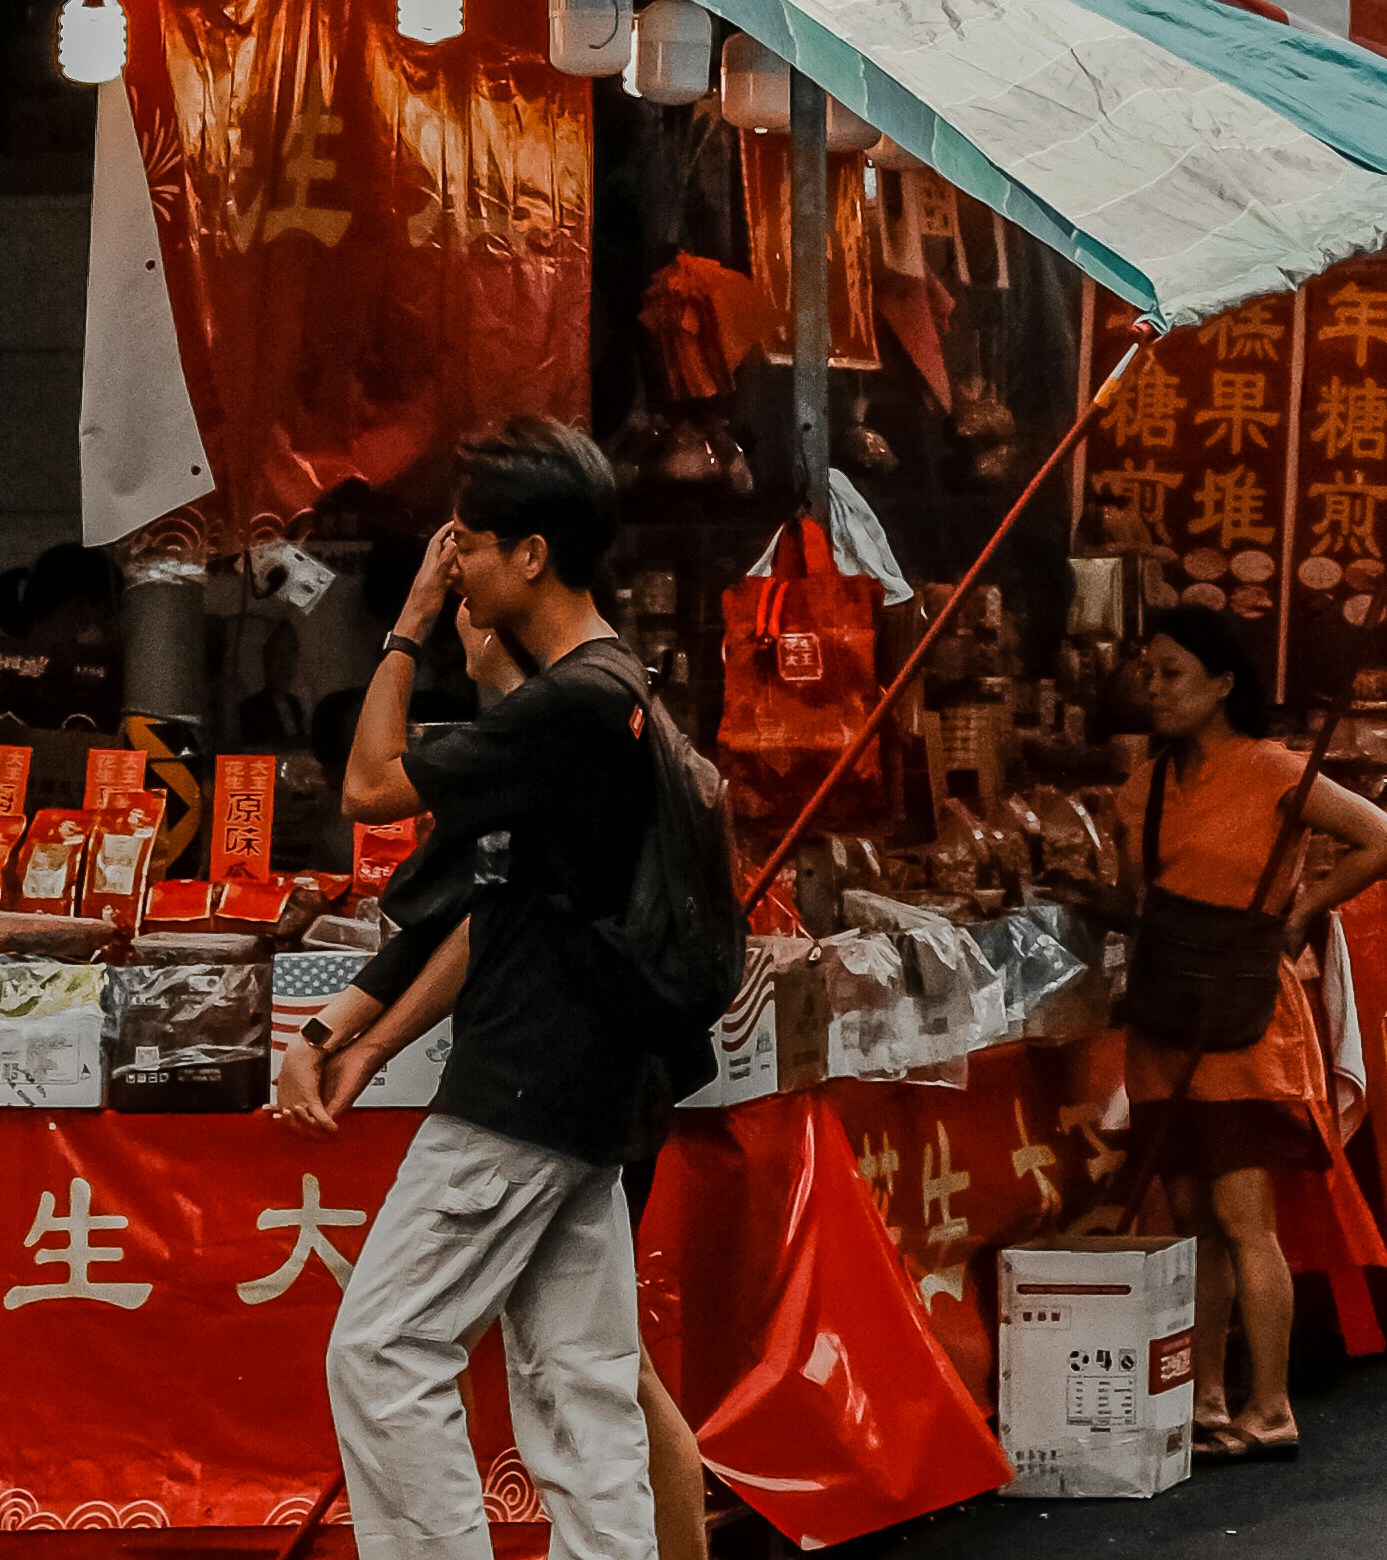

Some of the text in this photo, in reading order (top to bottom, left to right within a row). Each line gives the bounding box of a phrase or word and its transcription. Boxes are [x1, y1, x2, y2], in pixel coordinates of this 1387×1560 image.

[1098, 370, 1281, 457] 糖果
[120, 755, 142, 784] 大王
[249, 760, 269, 790] 大王
